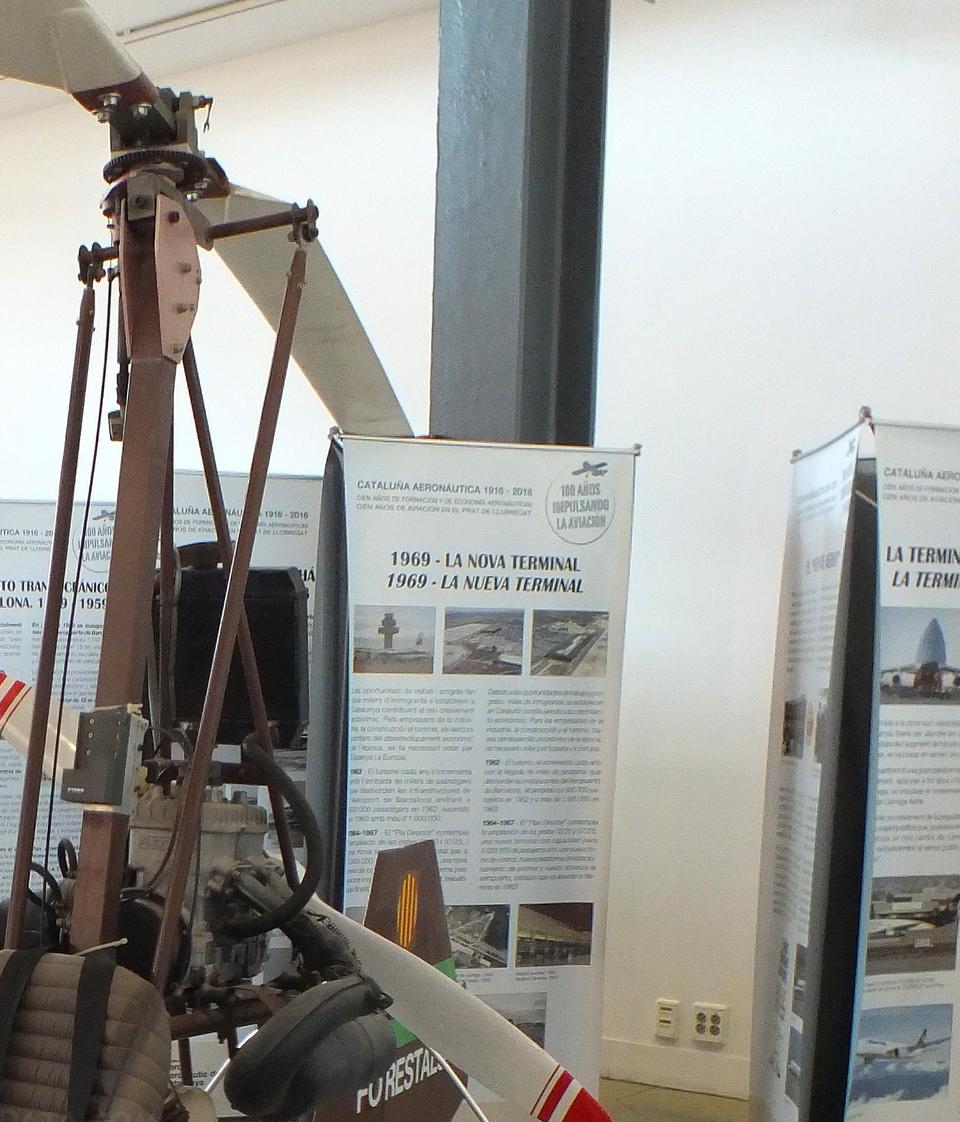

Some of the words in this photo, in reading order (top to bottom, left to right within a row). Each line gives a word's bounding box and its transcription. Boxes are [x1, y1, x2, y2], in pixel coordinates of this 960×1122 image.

[391, 551, 431, 566] 1969
[445, 553, 462, 568] LA
[468, 554, 506, 569] NOVA
[511, 555, 581, 572] TERMINAL
[886, 545, 903, 562] LA
[387, 573, 428, 588] 1969
[441, 575, 458, 589] LA
[463, 576, 510, 591] NUEVA
[516, 577, 584, 593] TERMINAL
[892, 570, 909, 587] LA
